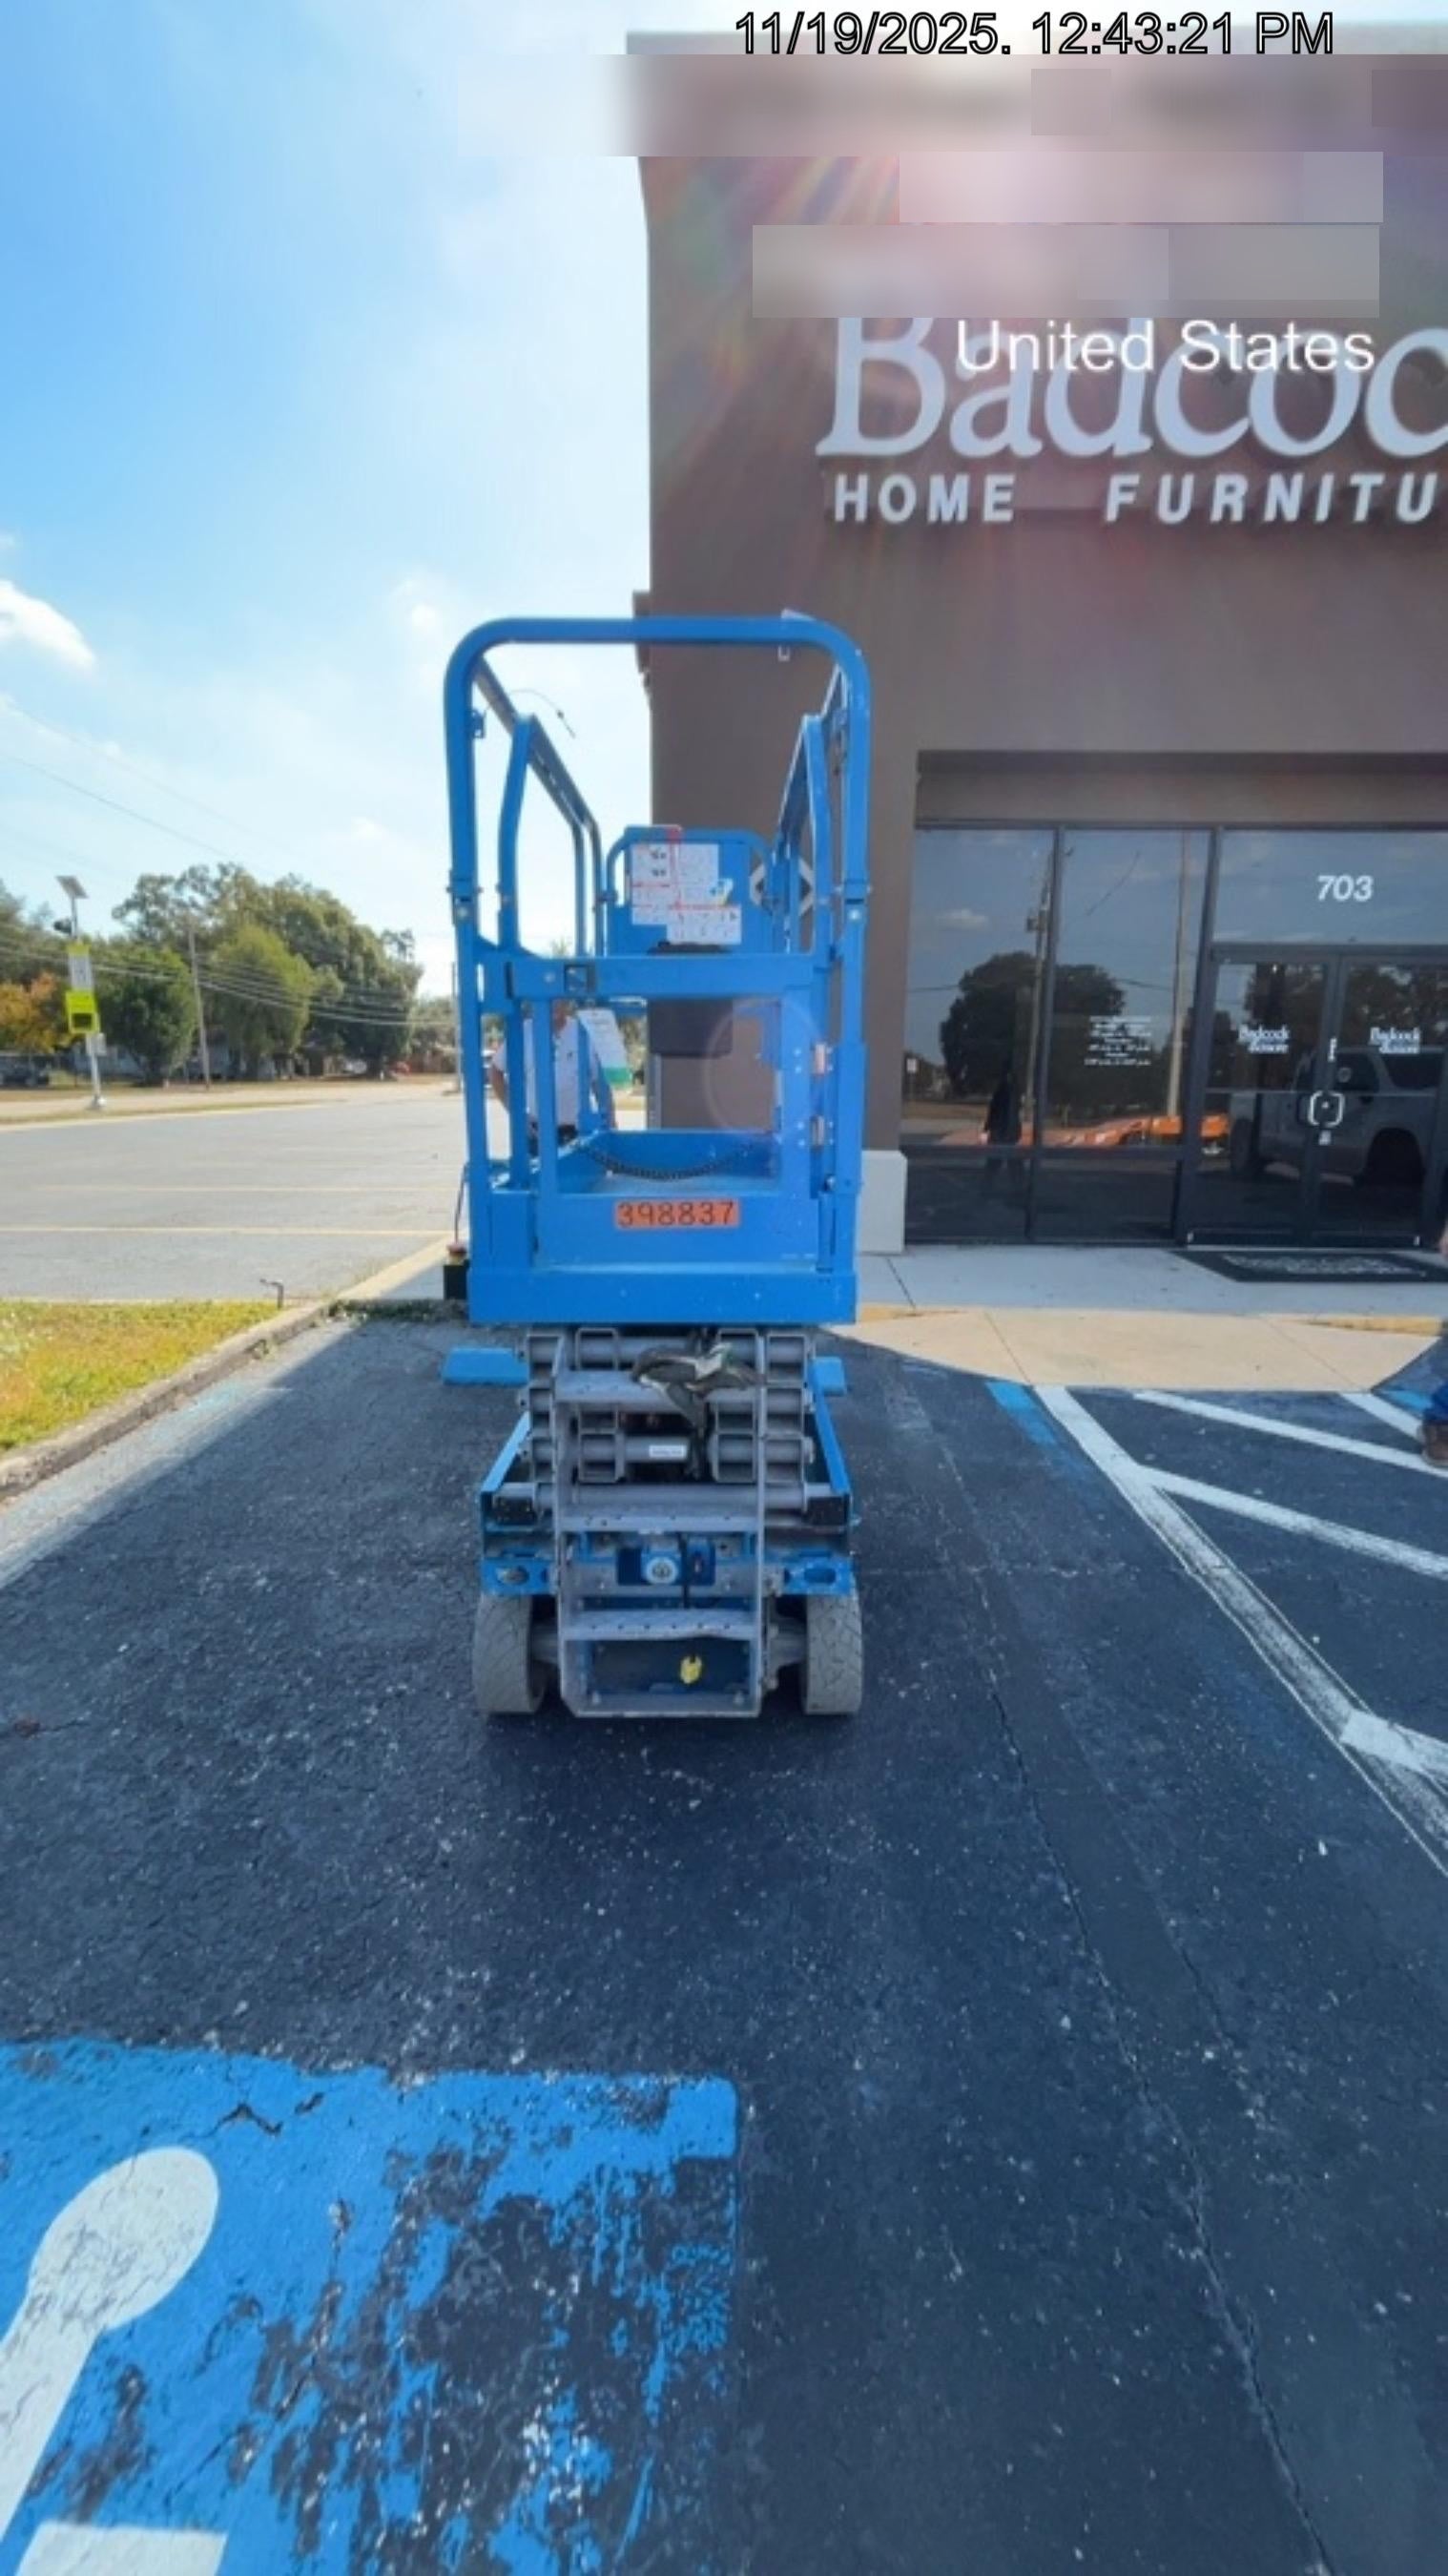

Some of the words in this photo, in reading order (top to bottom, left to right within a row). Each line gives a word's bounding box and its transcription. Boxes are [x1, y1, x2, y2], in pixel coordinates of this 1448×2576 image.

[834, 474, 1015, 524] HOME
[1317, 875, 1374, 903] 703
[617, 1200, 734, 1229] 398837
